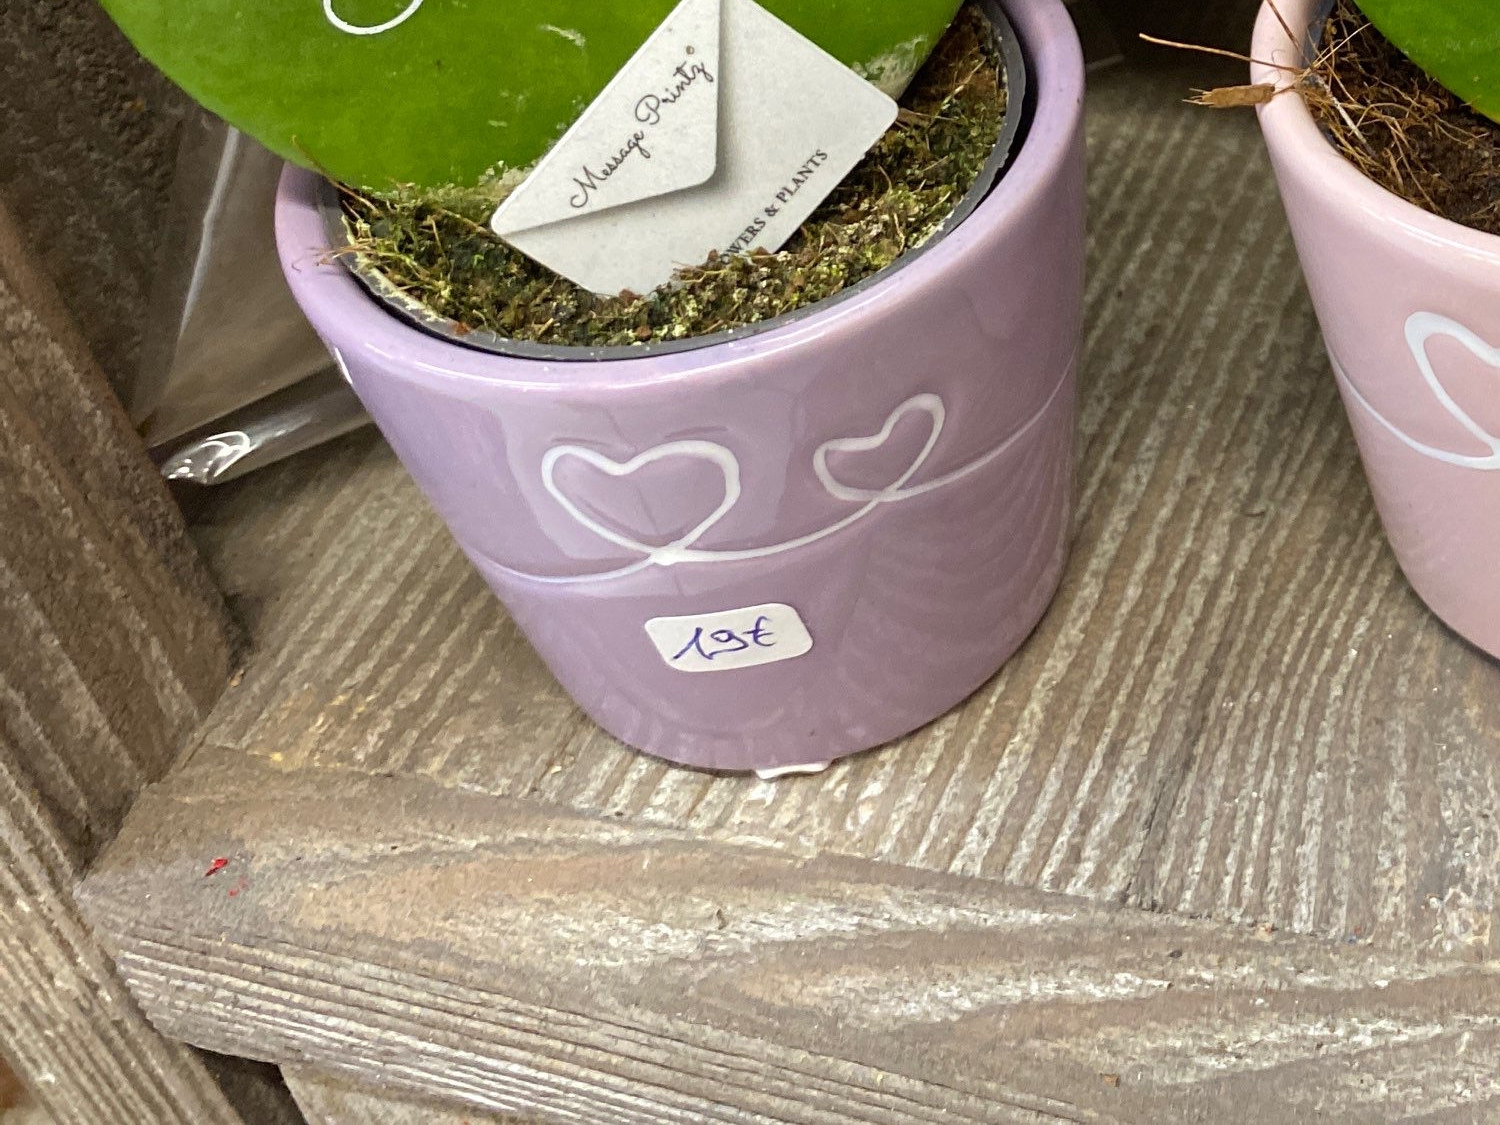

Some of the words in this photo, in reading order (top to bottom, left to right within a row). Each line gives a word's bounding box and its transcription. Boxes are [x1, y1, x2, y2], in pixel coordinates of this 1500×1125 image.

[569, 130, 651, 209] Message
[719, 217, 766, 266] OWERS
[764, 203, 780, 217] &
[775, 148, 828, 203] PLANTS
[671, 615, 777, 661] 19€
